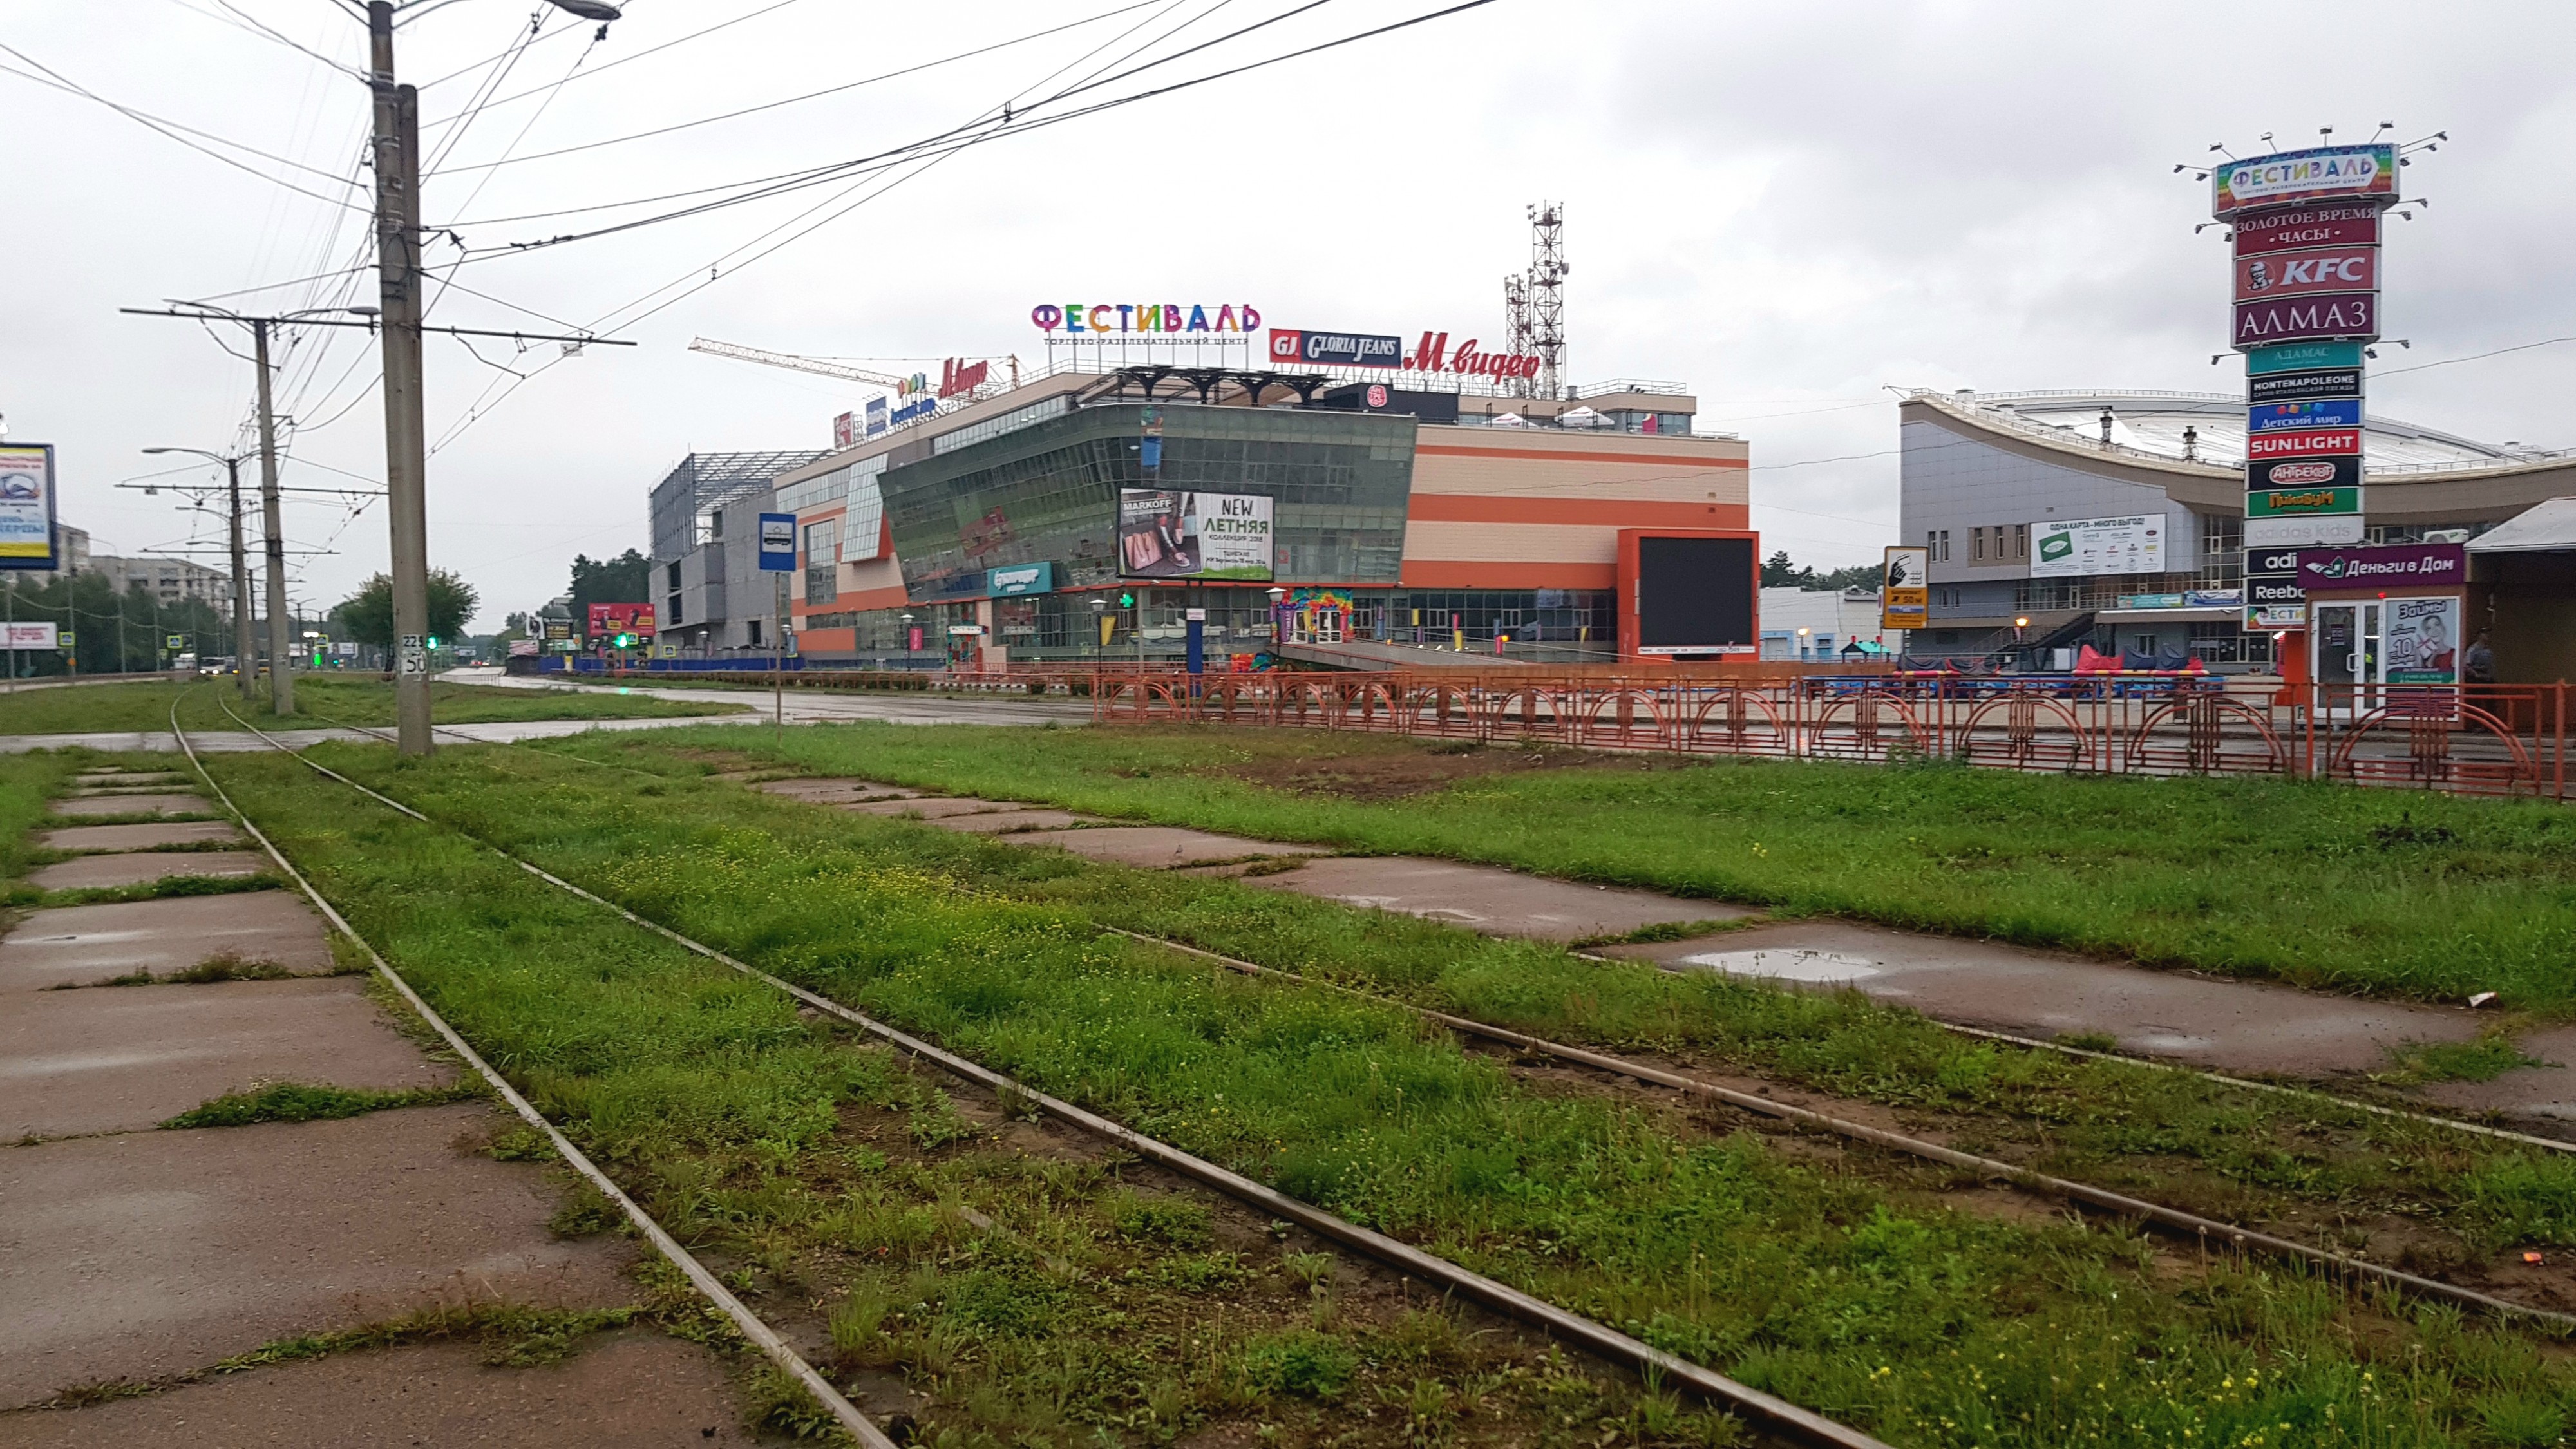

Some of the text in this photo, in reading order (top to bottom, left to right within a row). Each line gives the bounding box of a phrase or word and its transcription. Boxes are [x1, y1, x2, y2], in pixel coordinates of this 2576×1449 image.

[2233, 158, 2372, 187] ФЕСТИВАЛЬ
[2237, 207, 2376, 234] ЗОЛОТОЕ ВРЕМЯ
[2278, 227, 2331, 243] ЧАСЫ
[2279, 256, 2365, 286] KFC
[1032, 304, 1261, 332] ФЕСТИВАЛЬ
[2239, 301, 2367, 337] АЛМАЗ
[1214, 337, 1249, 346] ЦЕНТР
[1273, 336, 1297, 356] GJ
[1307, 336, 1396, 361] GLORIA JEANS
[2254, 375, 2355, 391] MONTENAPOLEONE
[2261, 415, 2342, 429] Детский мир
[2251, 435, 2354, 453] SUNLIGHT
[1123, 499, 1172, 511] MARKOFF
[1222, 498, 1253, 516] NEW
[1204, 518, 1269, 534] ЛЕТНЯЯ
[2069, 521, 2090, 529] КАРТА
[2094, 519, 2117, 528] МНОГО
[2265, 552, 2297, 569] adi
[2345, 556, 2454, 578] Деньги в Дом
[2255, 585, 2306, 599] Reebo
[2259, 610, 2305, 620] ФЕСТИ
[2398, 600, 2447, 619] Займы
[2393, 638, 2413, 657] 10
